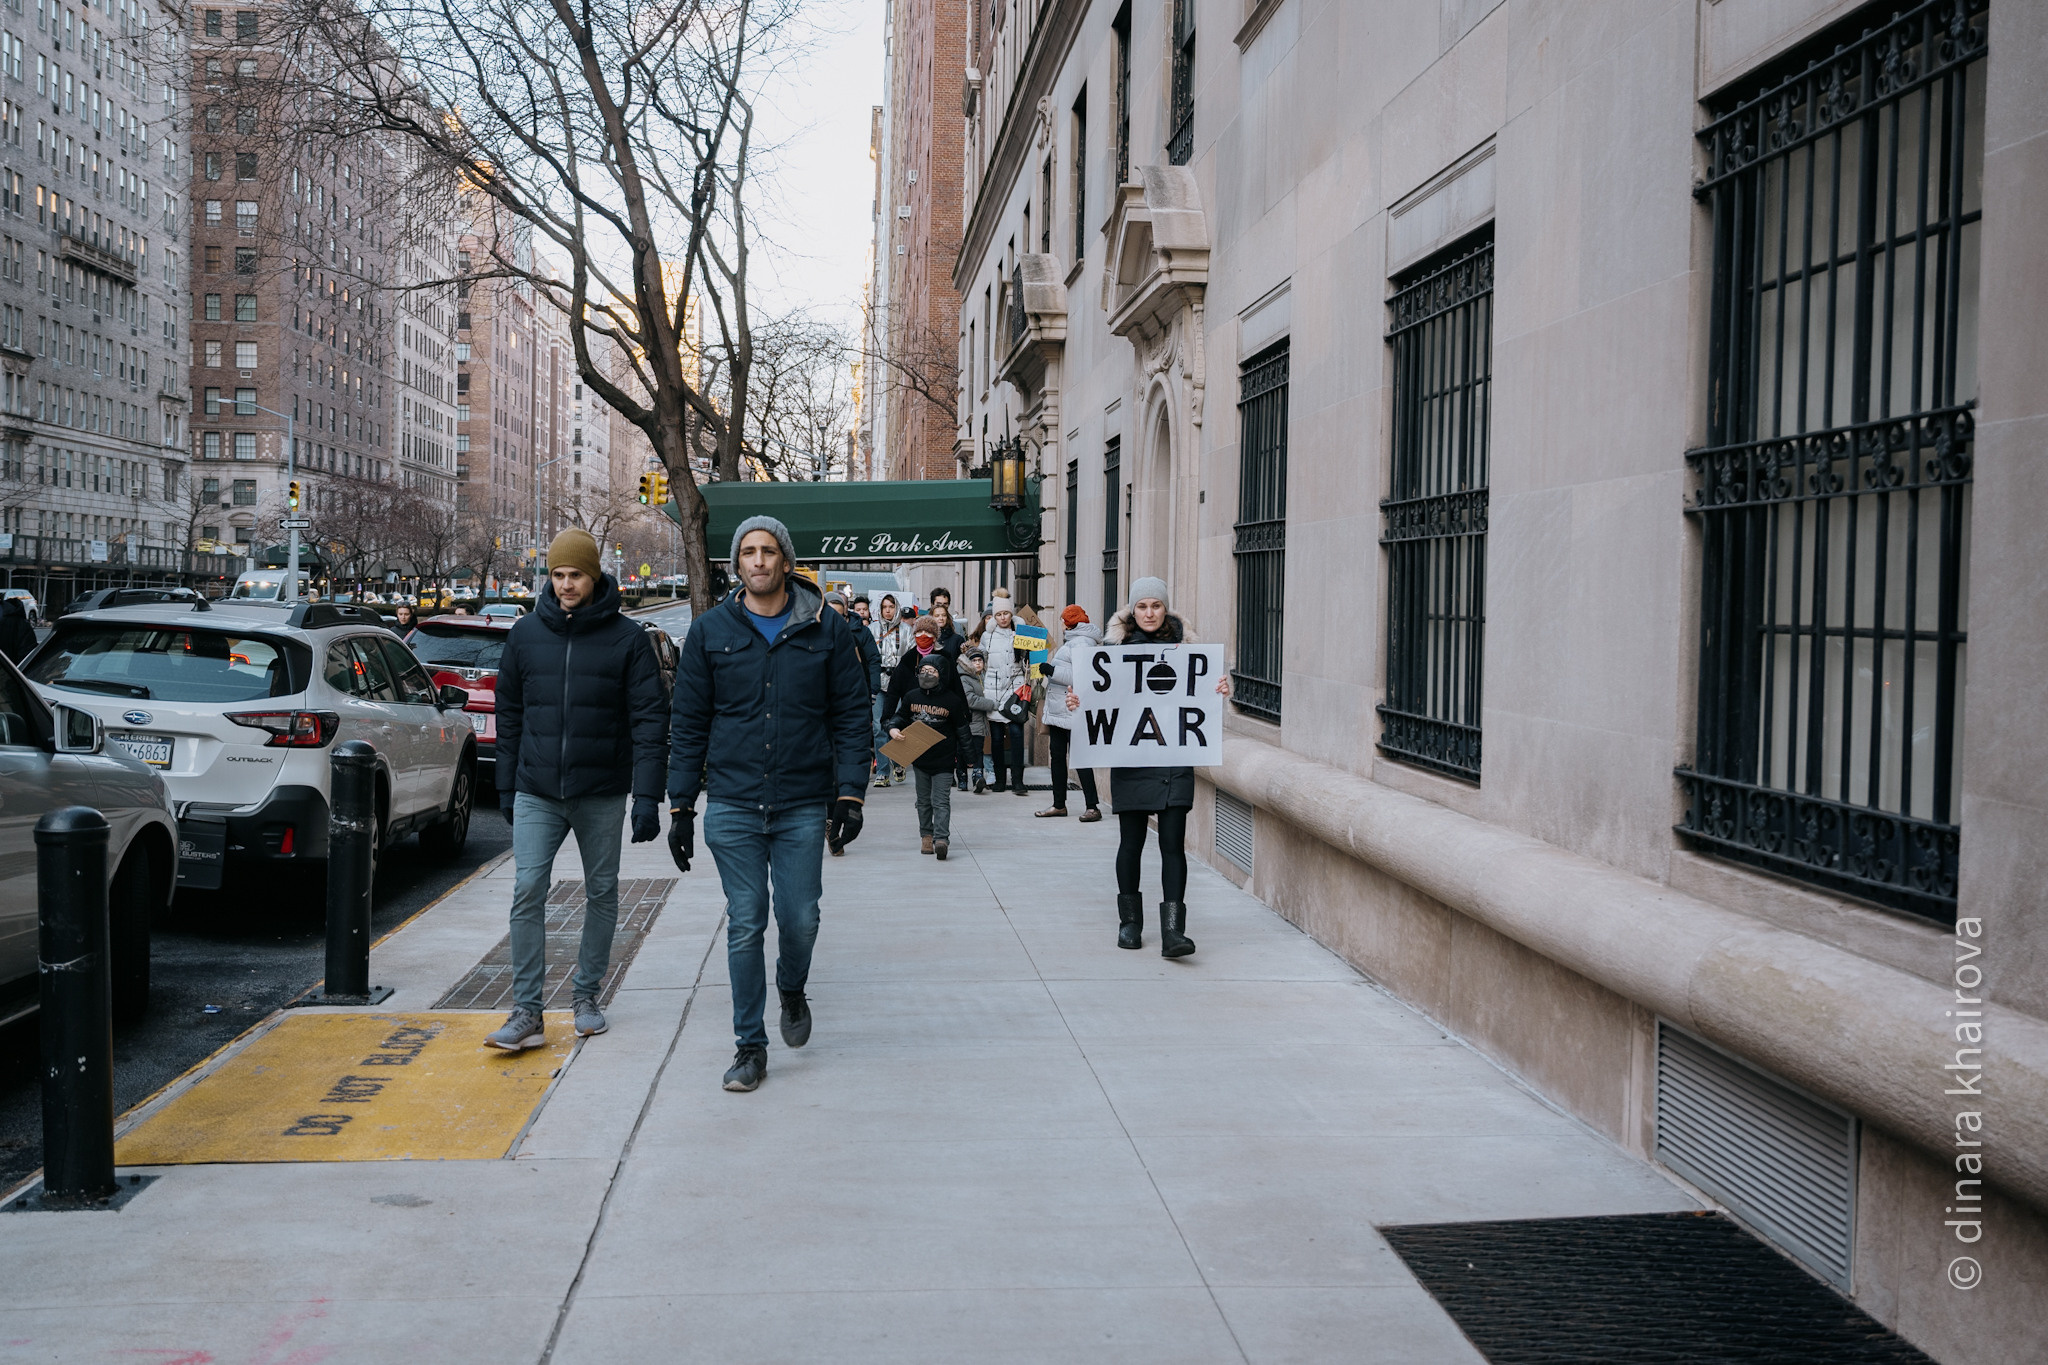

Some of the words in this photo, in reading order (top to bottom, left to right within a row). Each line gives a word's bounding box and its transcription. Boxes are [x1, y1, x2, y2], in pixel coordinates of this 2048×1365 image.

[820, 536, 859, 554] 775
[868, 533, 926, 553] Park
[925, 531, 973, 552] Ave.
[1014, 638, 1031, 648] STOP
[1032, 641, 1044, 650] WAR
[1085, 706, 1208, 747] WAR
[281, 1114, 353, 1136] DO
[320, 1075, 393, 1103] NOT
[359, 1027, 440, 1066] BLOCK
